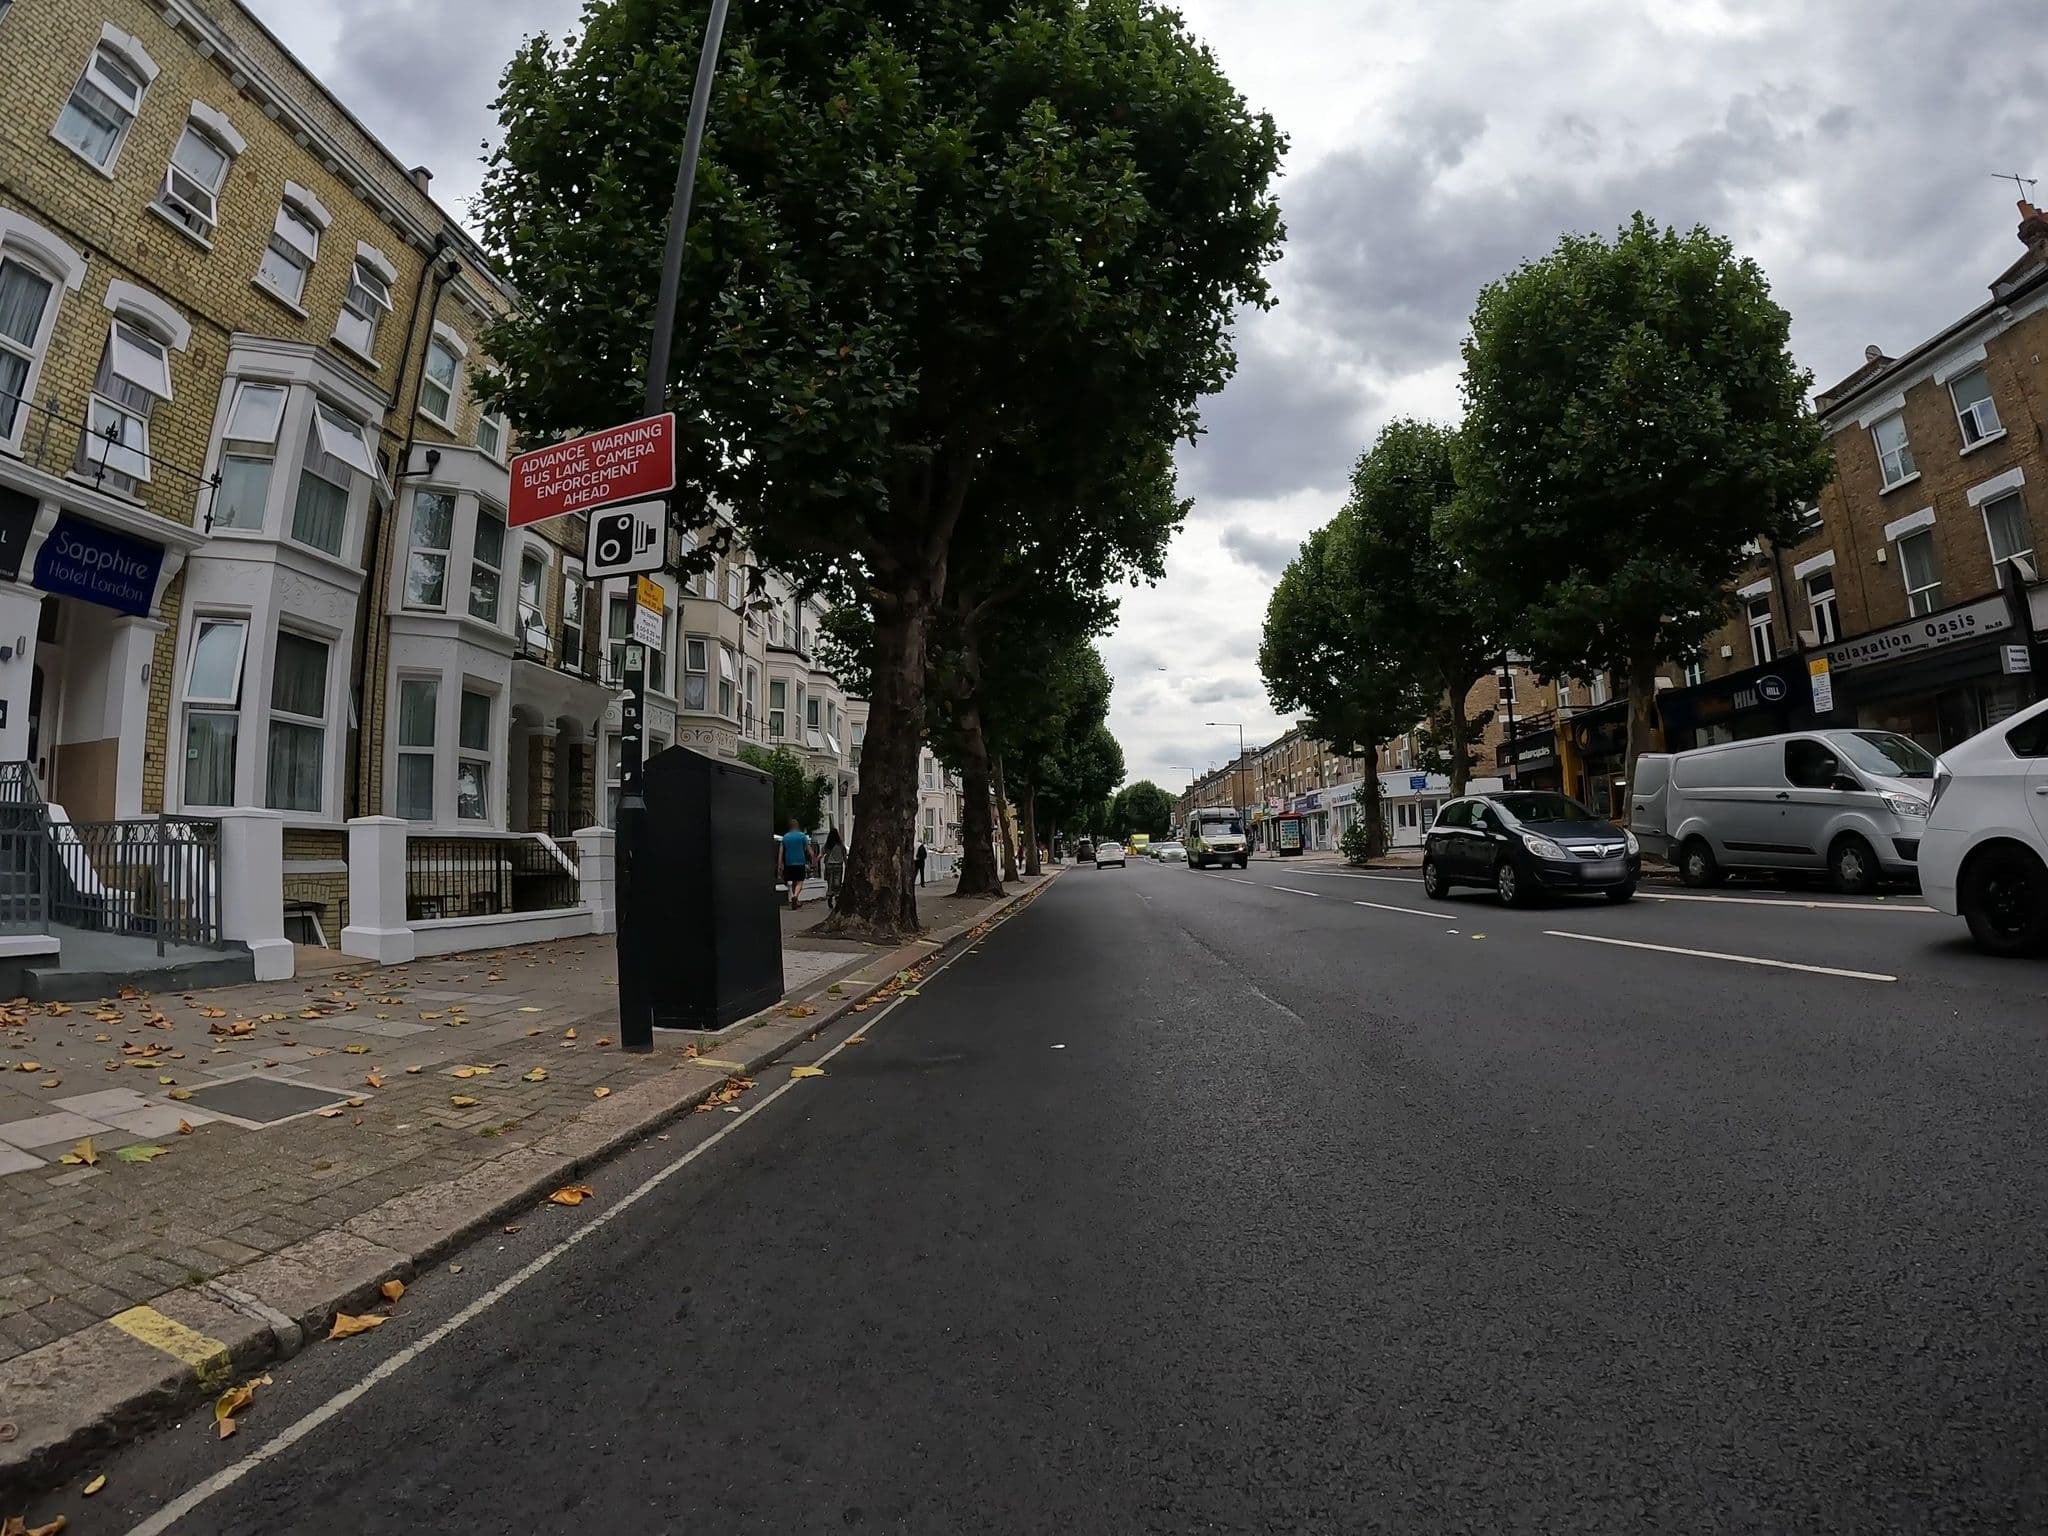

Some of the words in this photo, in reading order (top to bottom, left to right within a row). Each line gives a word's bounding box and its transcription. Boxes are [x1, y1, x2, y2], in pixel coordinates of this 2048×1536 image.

[520, 444, 586, 475] ADVANCE
[591, 423, 663, 453] WARNING
[524, 470, 550, 489] BUS
[555, 458, 590, 479] LANE
[596, 441, 656, 467] CAMERA
[536, 460, 640, 500] ENFORCEMENT
[563, 483, 610, 507] AHEAD
[56, 531, 148, 579] Sapphire
[49, 560, 88, 585] Hotel
[91, 571, 143, 602] London
[1827, 633, 1912, 664] Relaxation
[1925, 614, 1975, 637] Oasis
[1733, 688, 1759, 710] HILL
[1765, 686, 1781, 696] HILL
